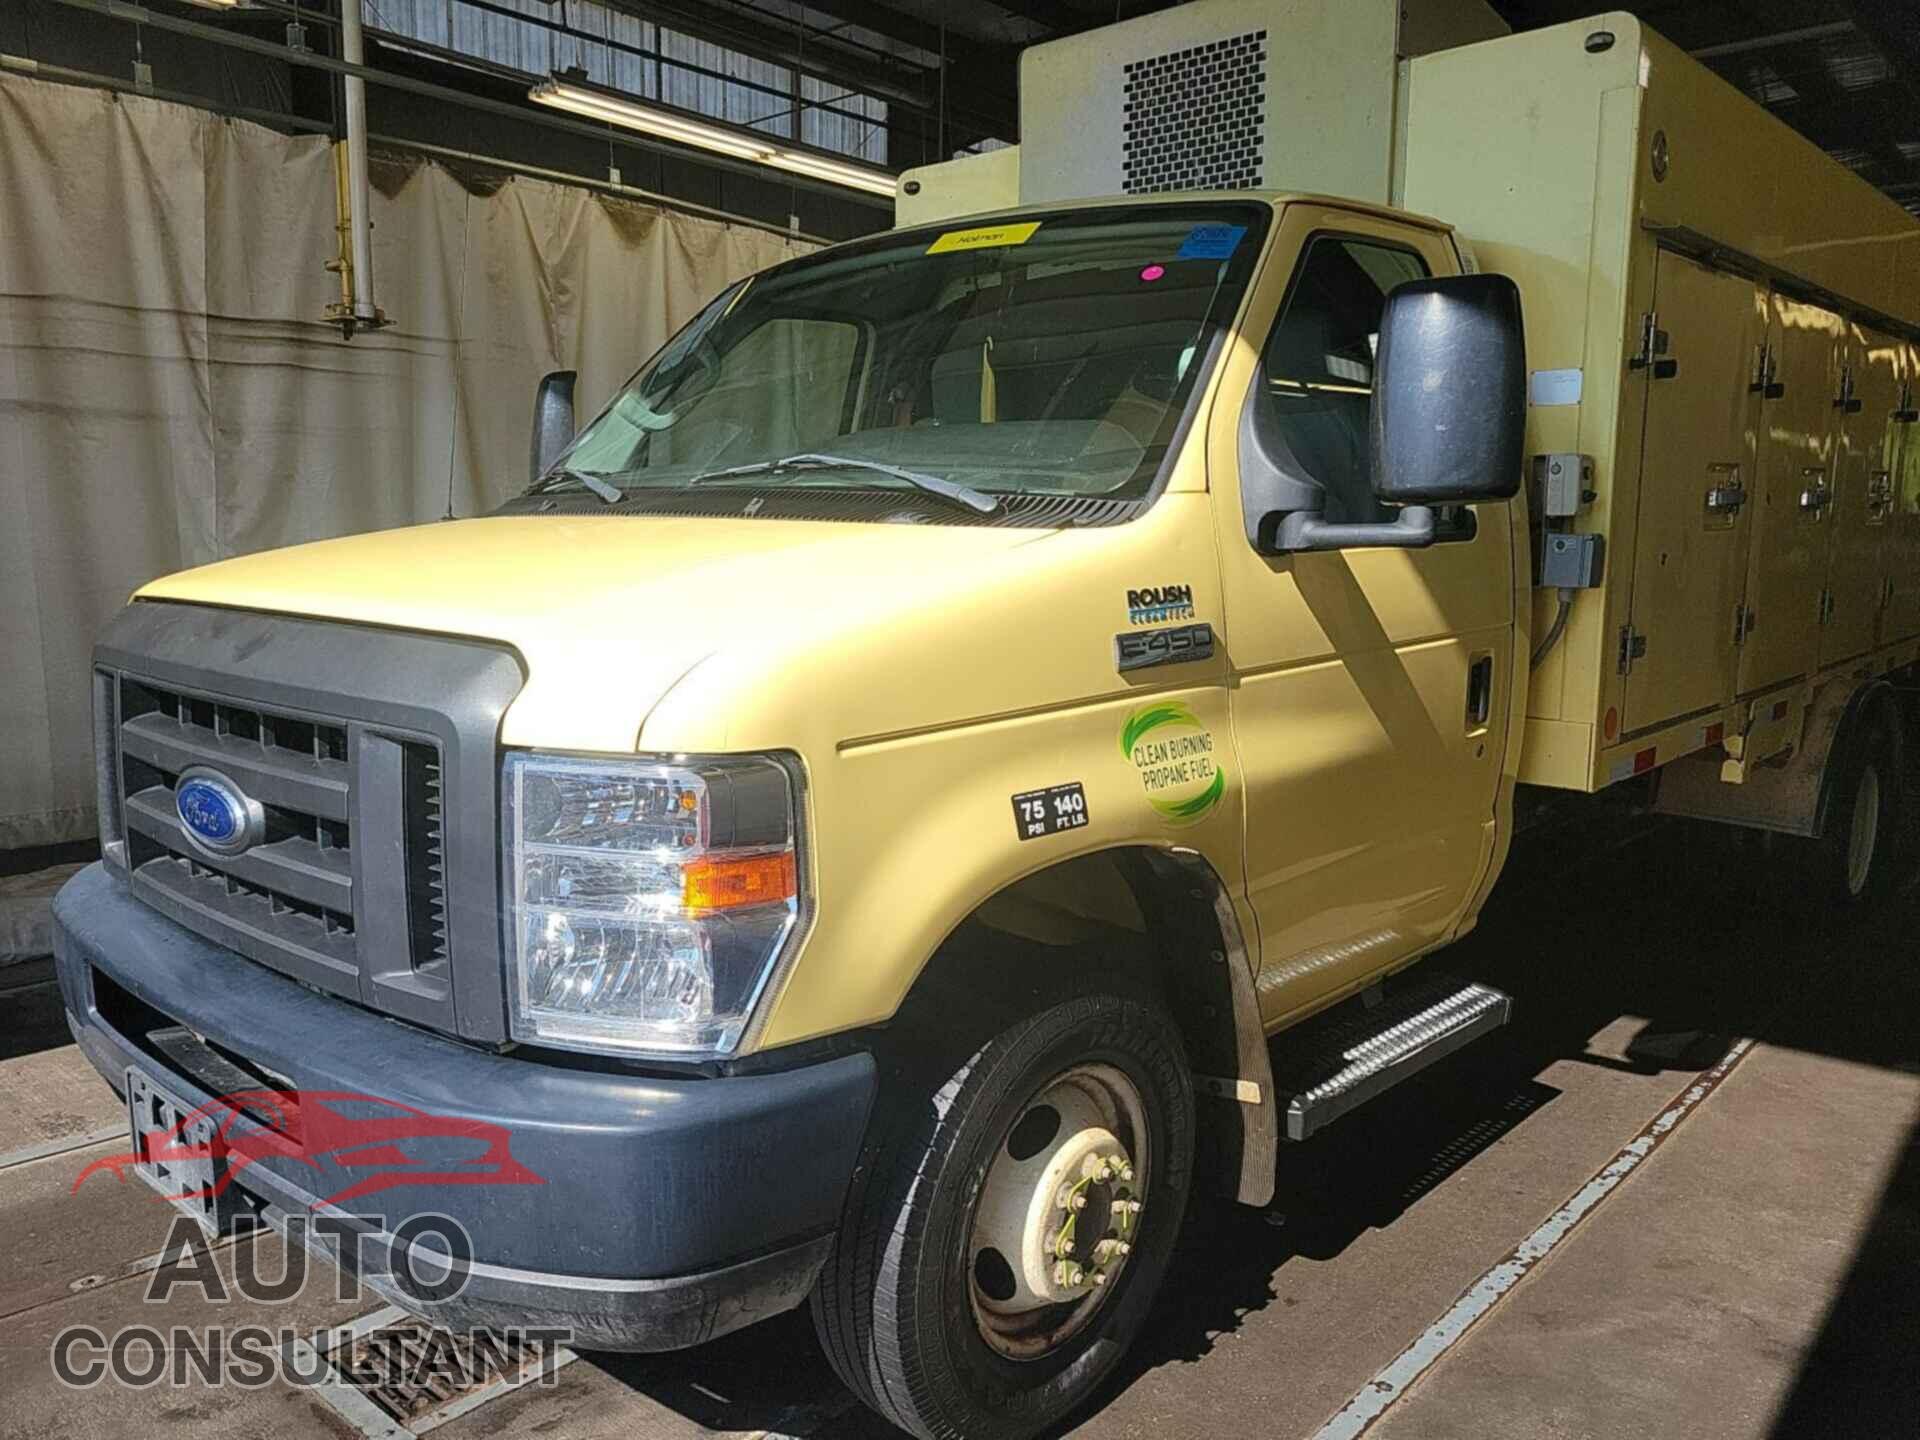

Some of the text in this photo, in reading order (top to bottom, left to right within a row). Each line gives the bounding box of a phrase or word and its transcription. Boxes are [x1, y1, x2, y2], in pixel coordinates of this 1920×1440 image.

[1126, 584, 1192, 609] ROUSH
[1134, 732, 1213, 768] CLEAN BURNING
[1142, 757, 1215, 792] PROPANE FUEL
[1020, 800, 1046, 822] 75
[1053, 793, 1084, 815] 140
[1027, 821, 1046, 836] PSI
